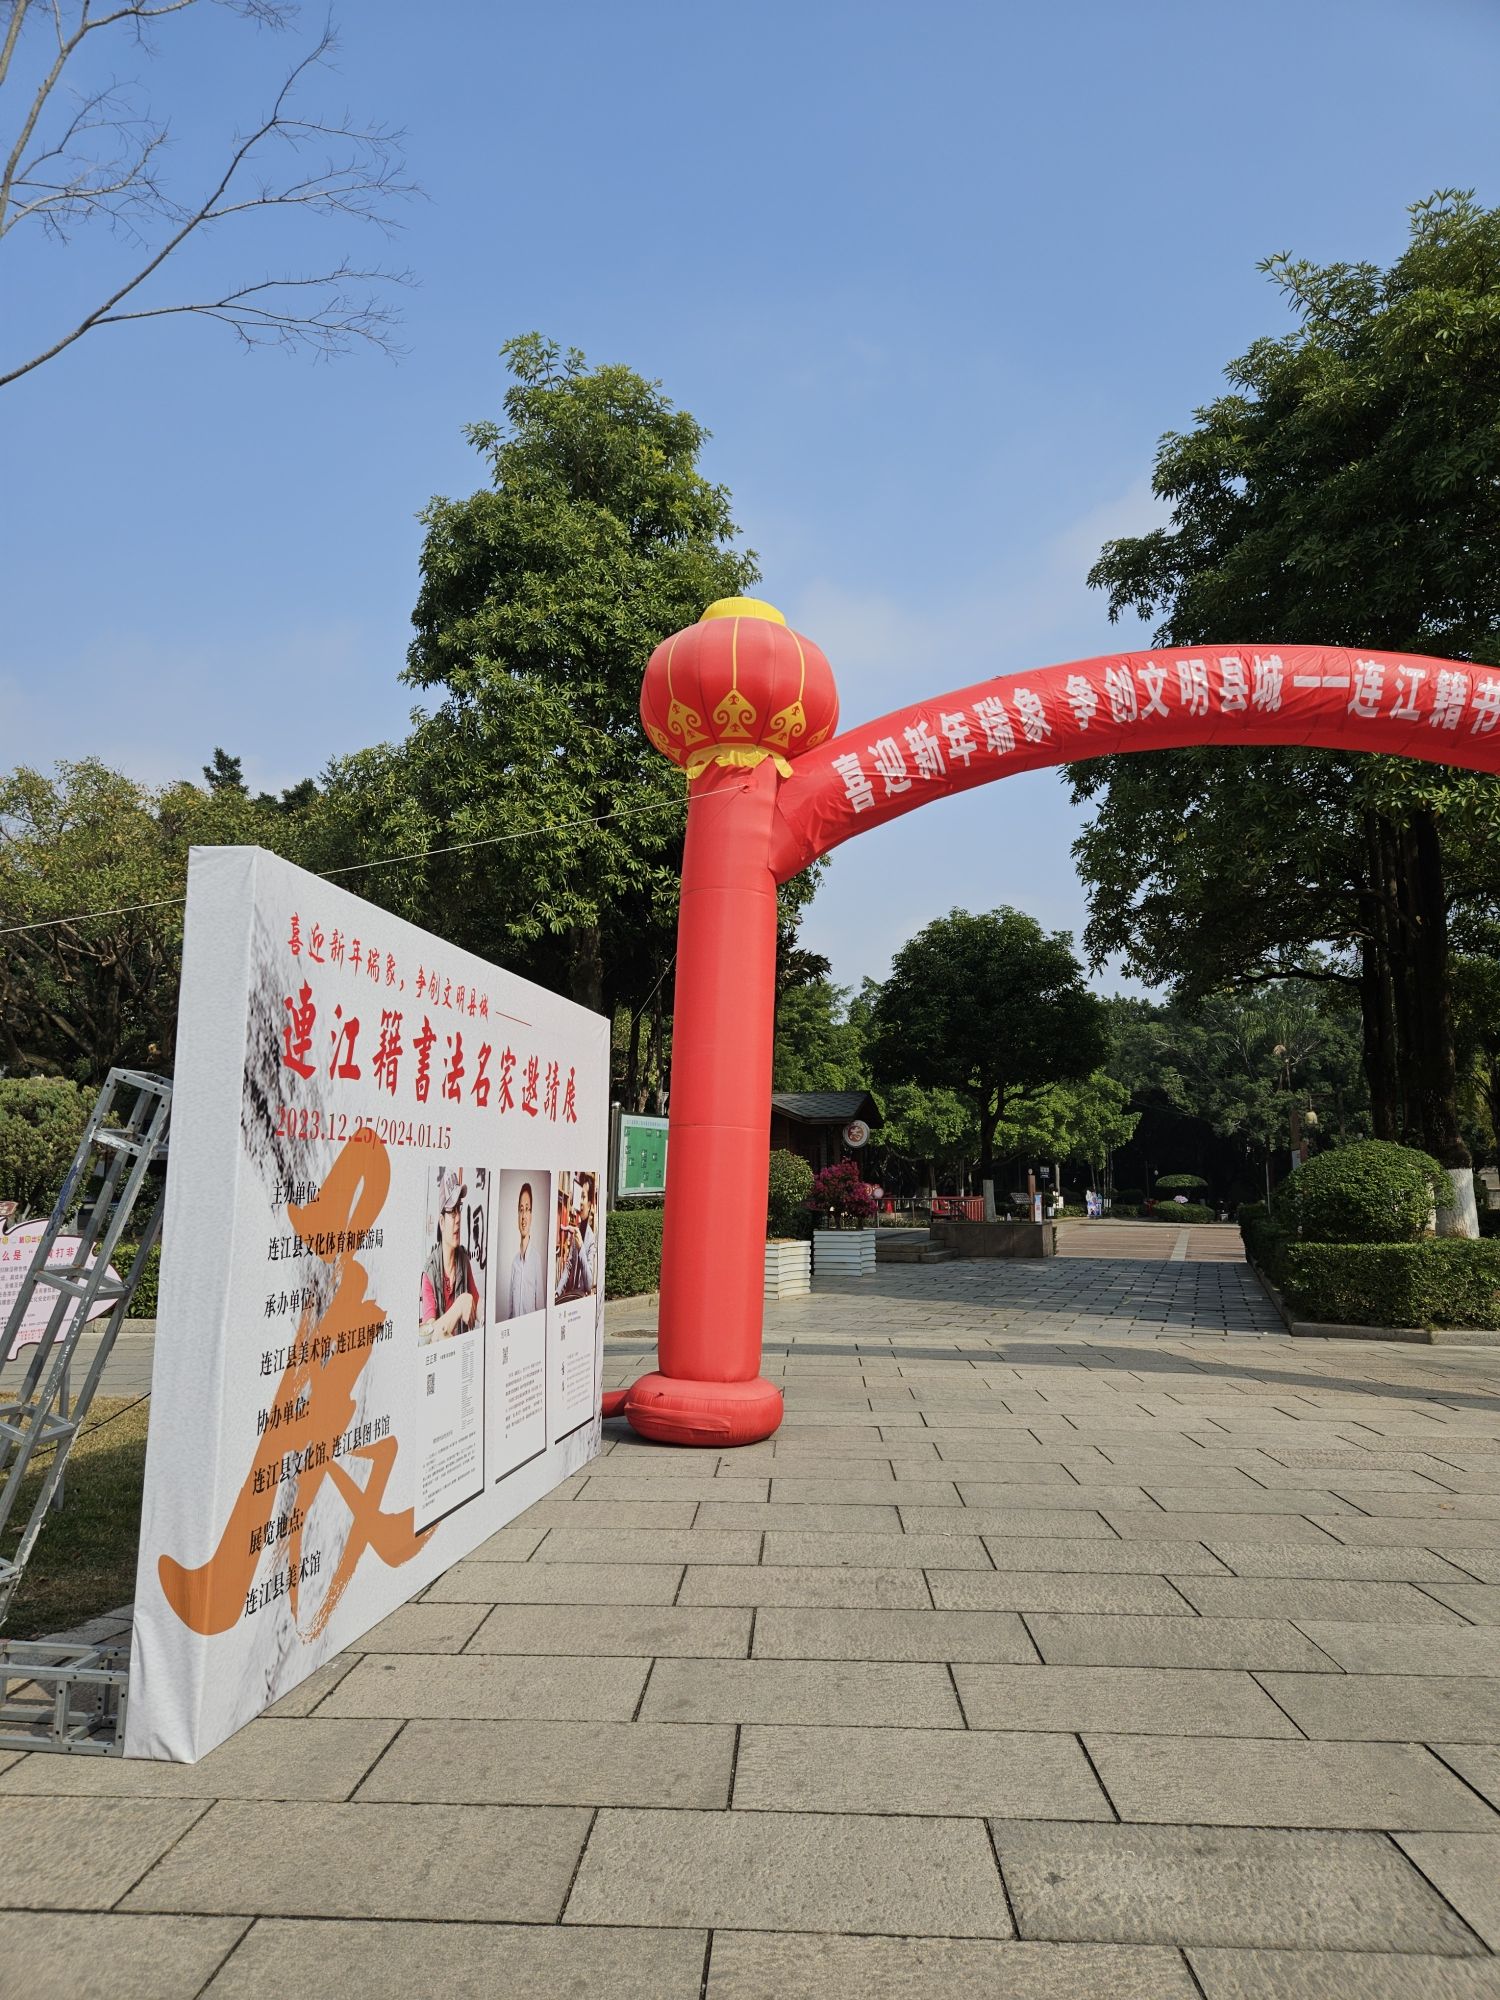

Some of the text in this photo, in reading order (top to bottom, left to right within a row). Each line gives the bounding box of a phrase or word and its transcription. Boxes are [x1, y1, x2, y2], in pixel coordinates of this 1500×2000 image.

[275, 1106, 452, 1150] 2023.12.25/2024.01.15
[267, 1228, 384, 1262] 连江县文化体育和旅游局
[244, 1550, 322, 1618] 连江县美术馆
